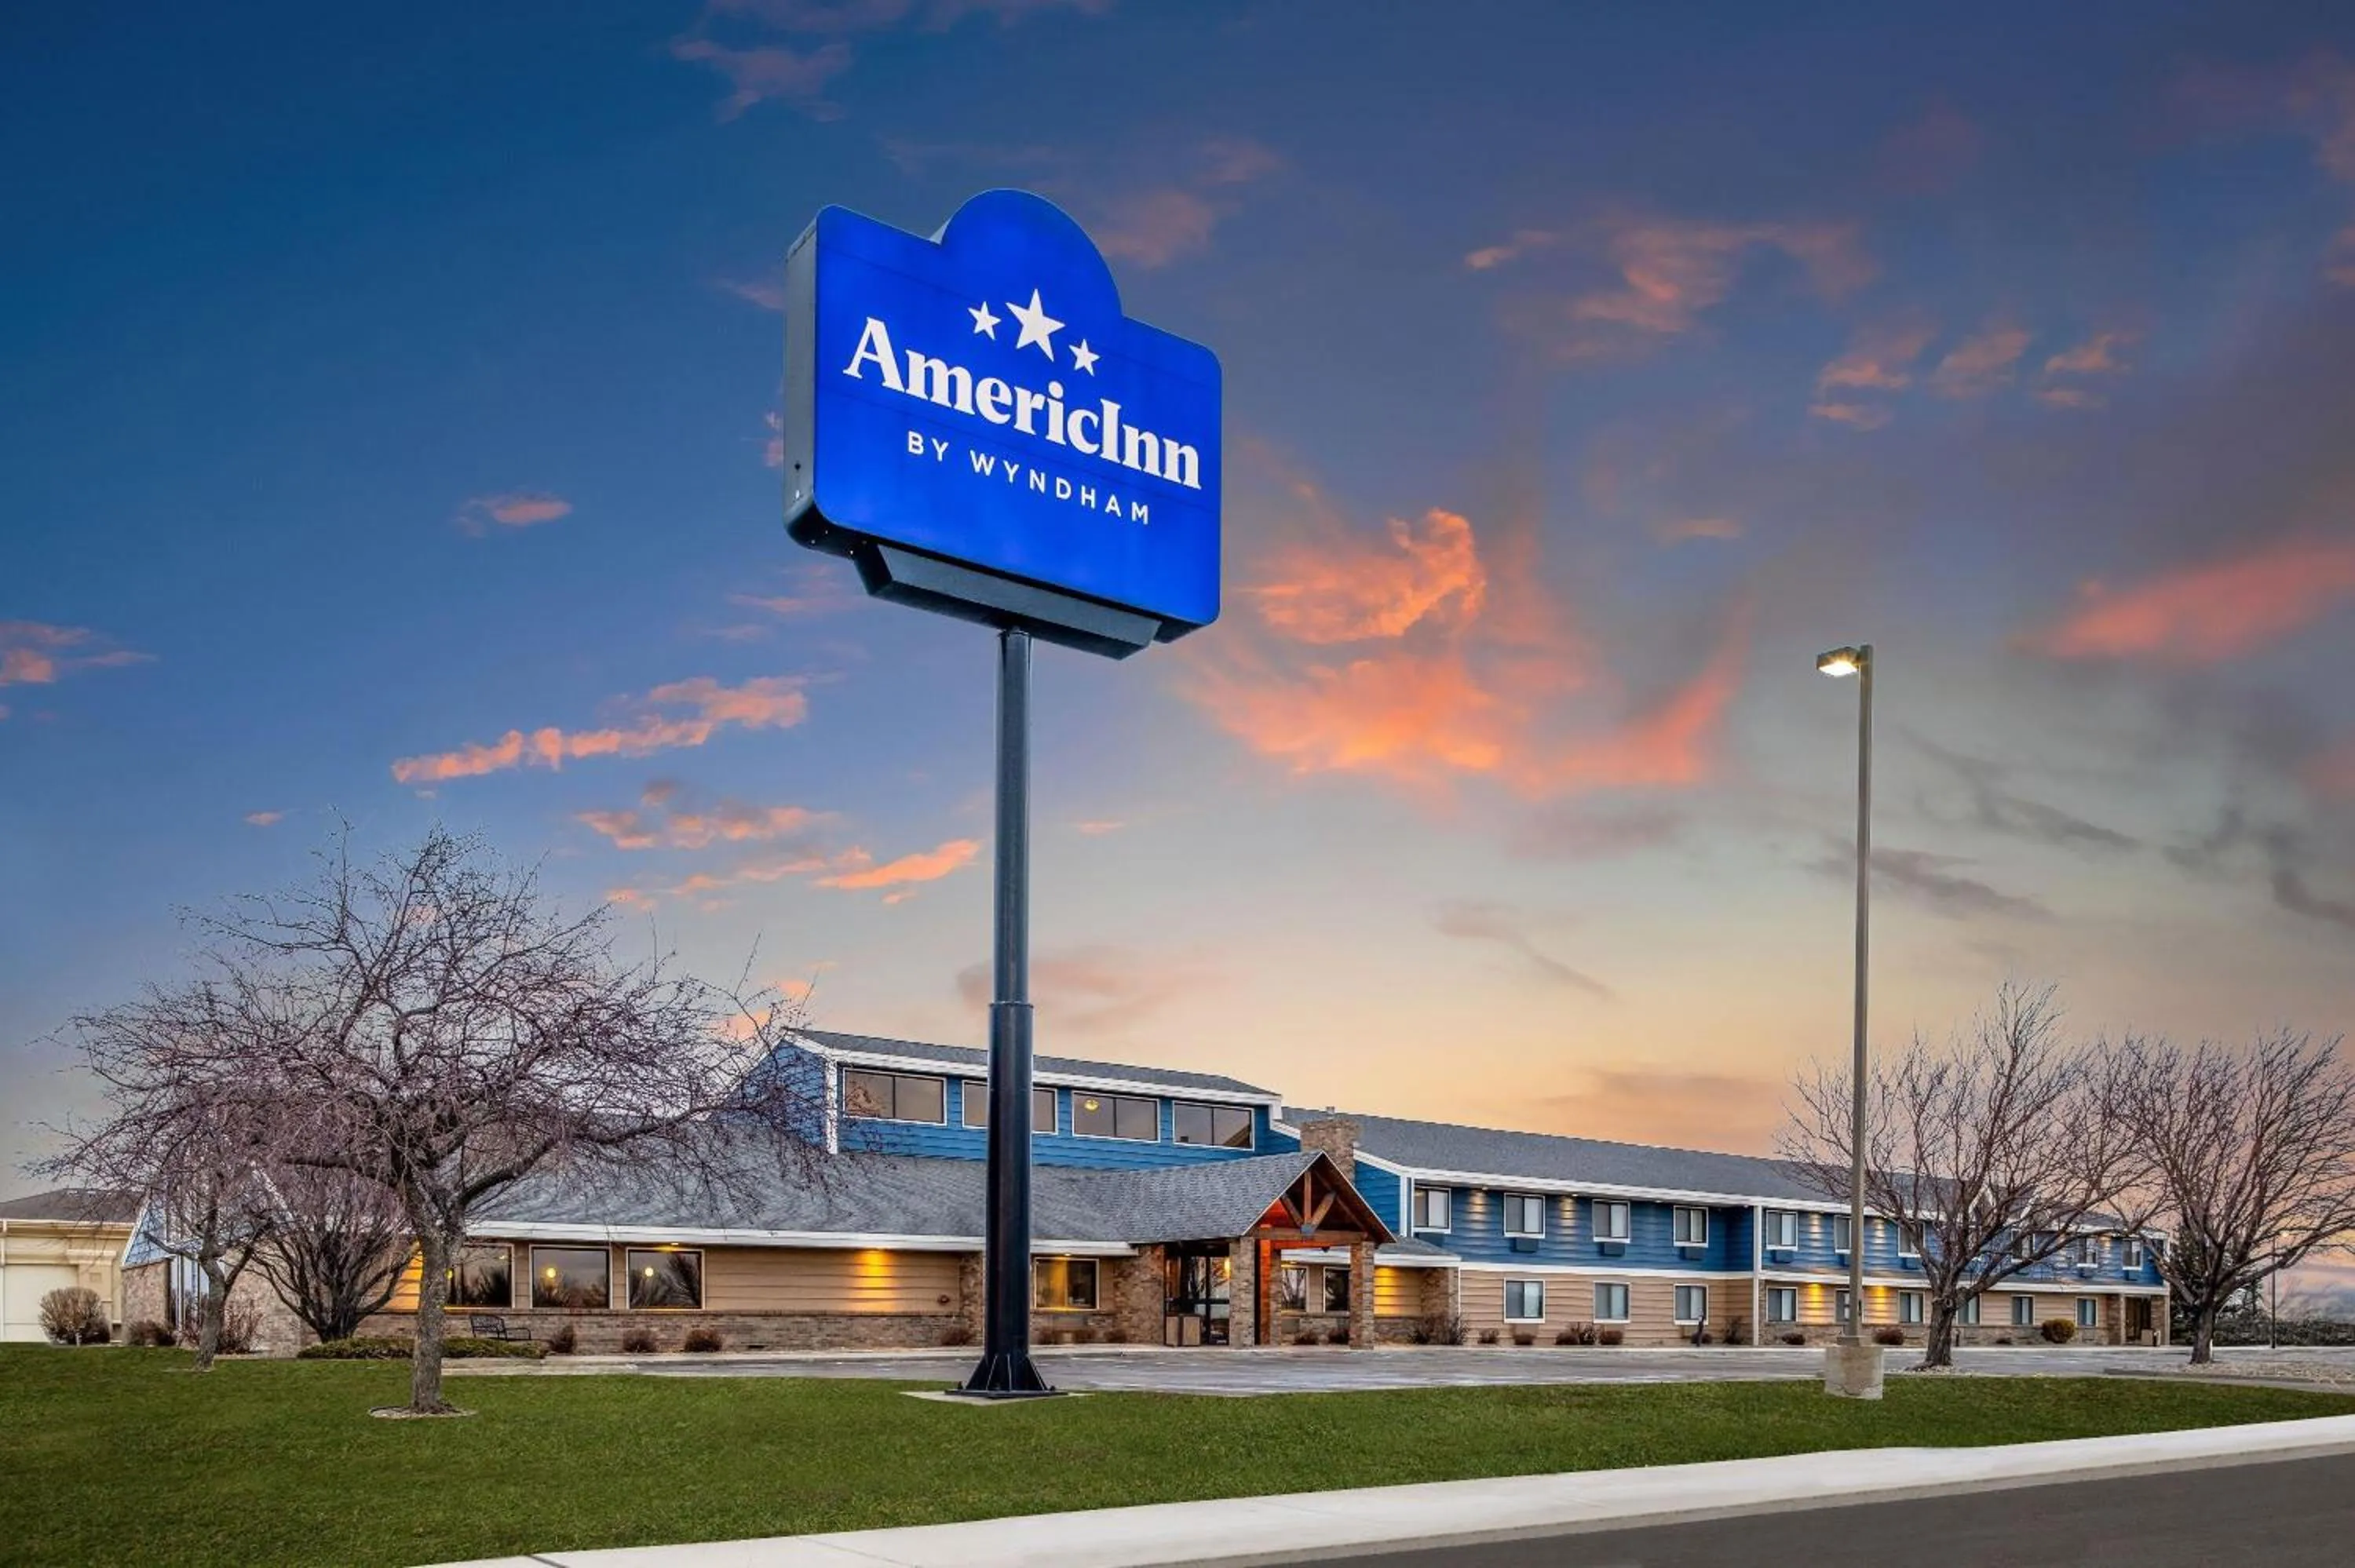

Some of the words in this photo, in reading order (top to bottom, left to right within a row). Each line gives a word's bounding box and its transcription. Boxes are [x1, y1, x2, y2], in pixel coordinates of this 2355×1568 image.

[842, 316, 1202, 490] AmericInn
[907, 431, 949, 461] BY
[969, 450, 1149, 525] WYNDHAM
